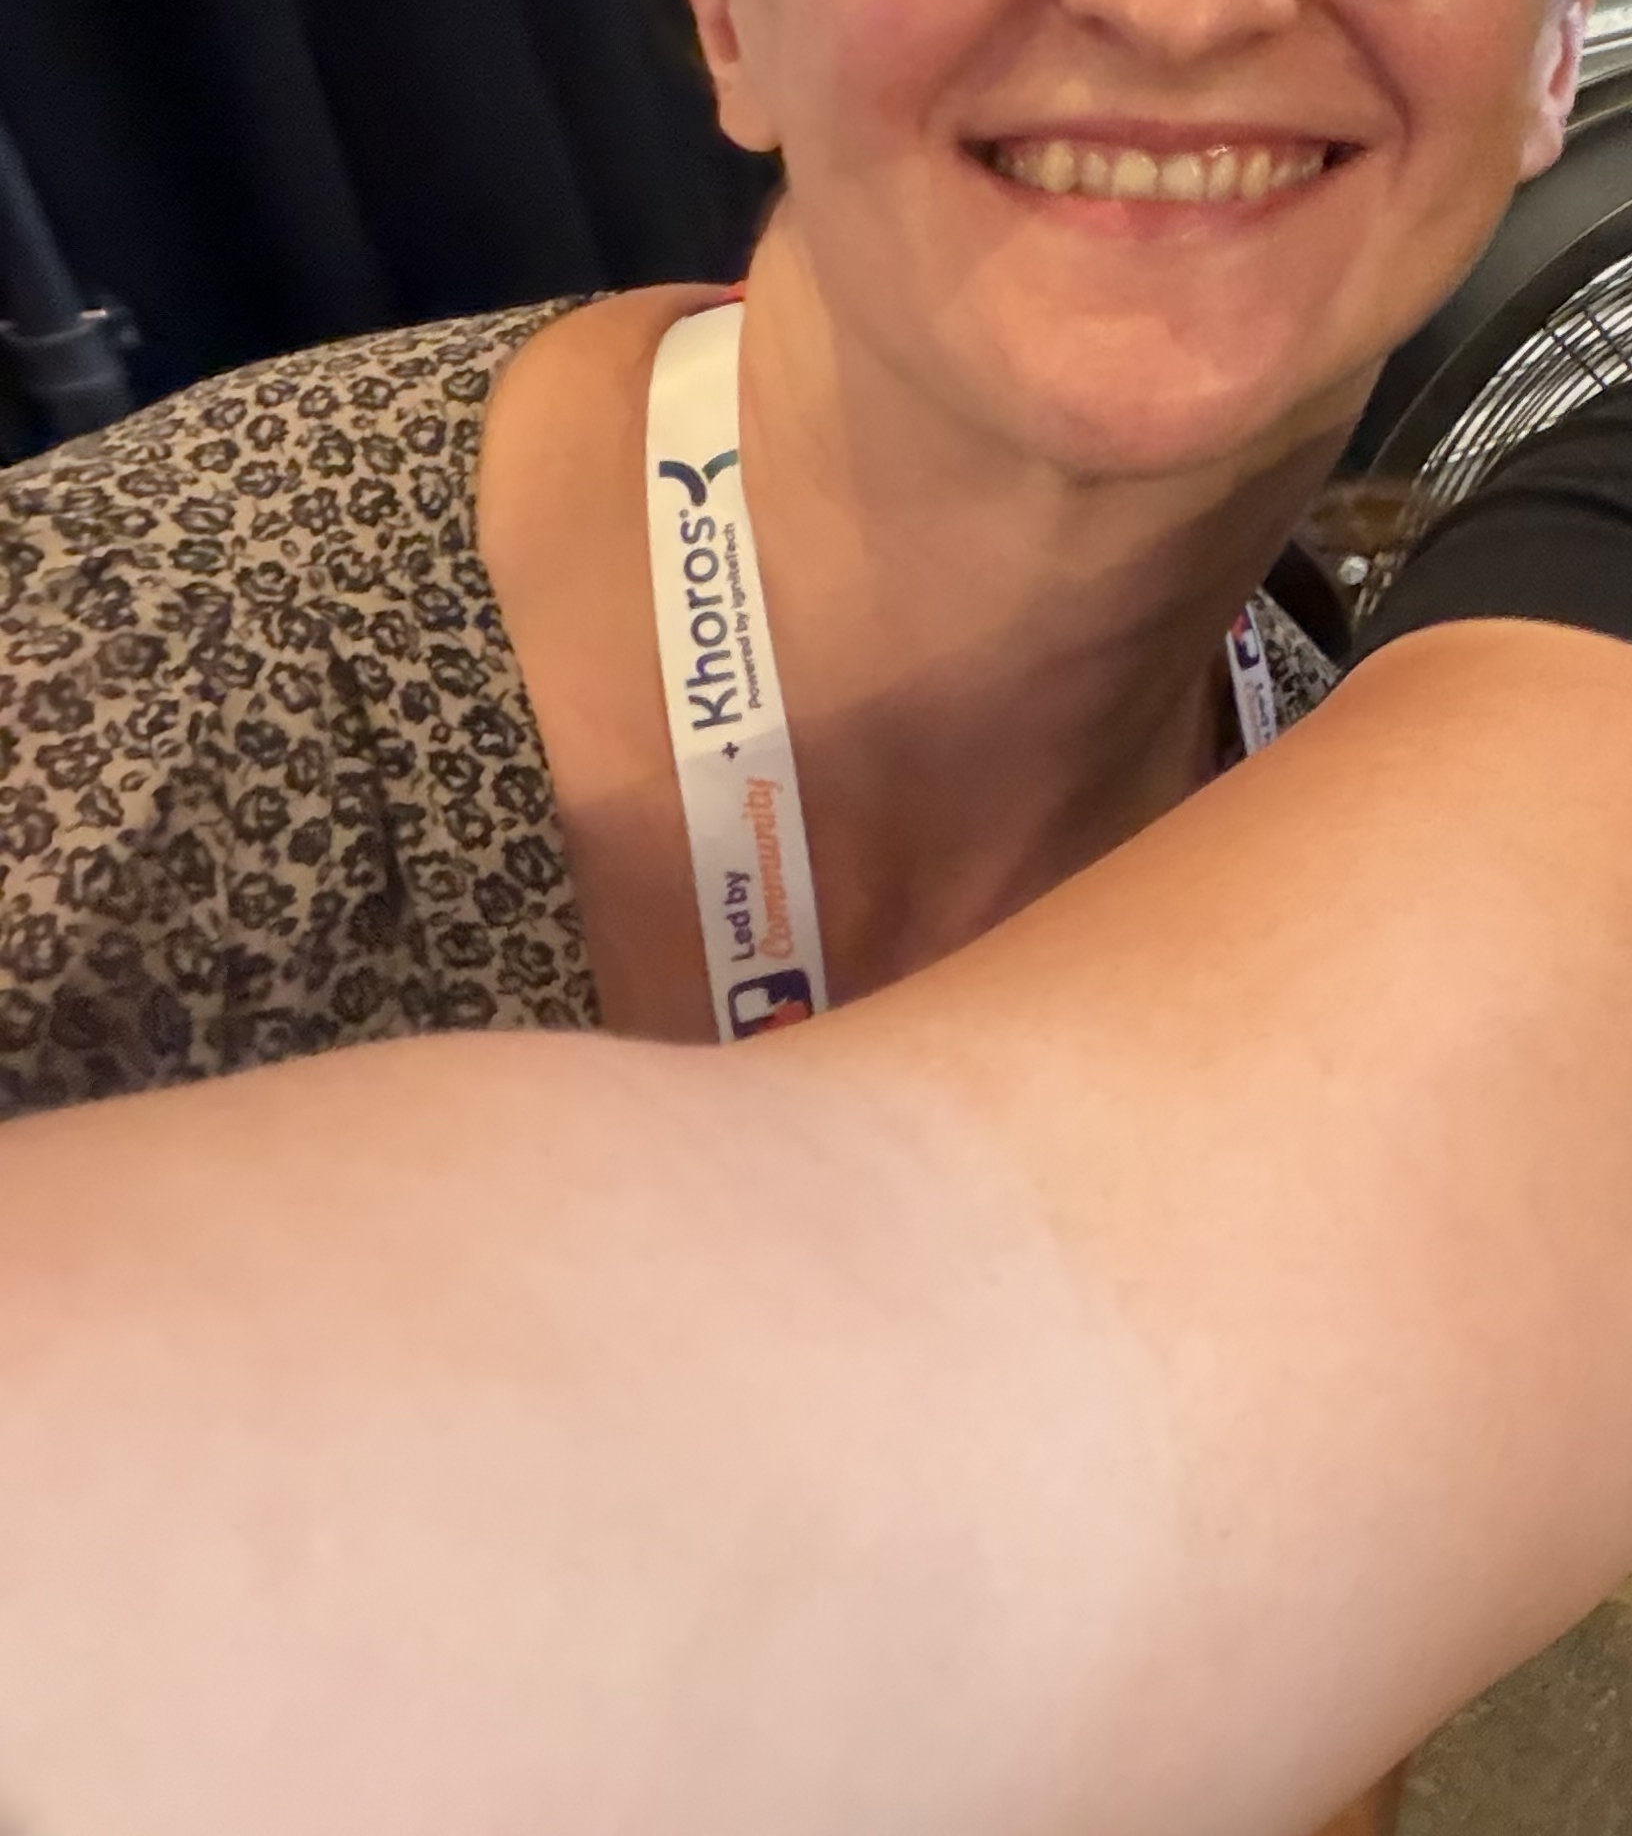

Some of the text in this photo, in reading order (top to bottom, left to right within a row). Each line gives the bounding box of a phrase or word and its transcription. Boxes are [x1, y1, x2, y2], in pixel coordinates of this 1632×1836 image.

[680, 516, 743, 730] Khoros
[735, 612, 750, 633] by
[725, 871, 756, 962] Led by
[742, 776, 794, 960] Community
